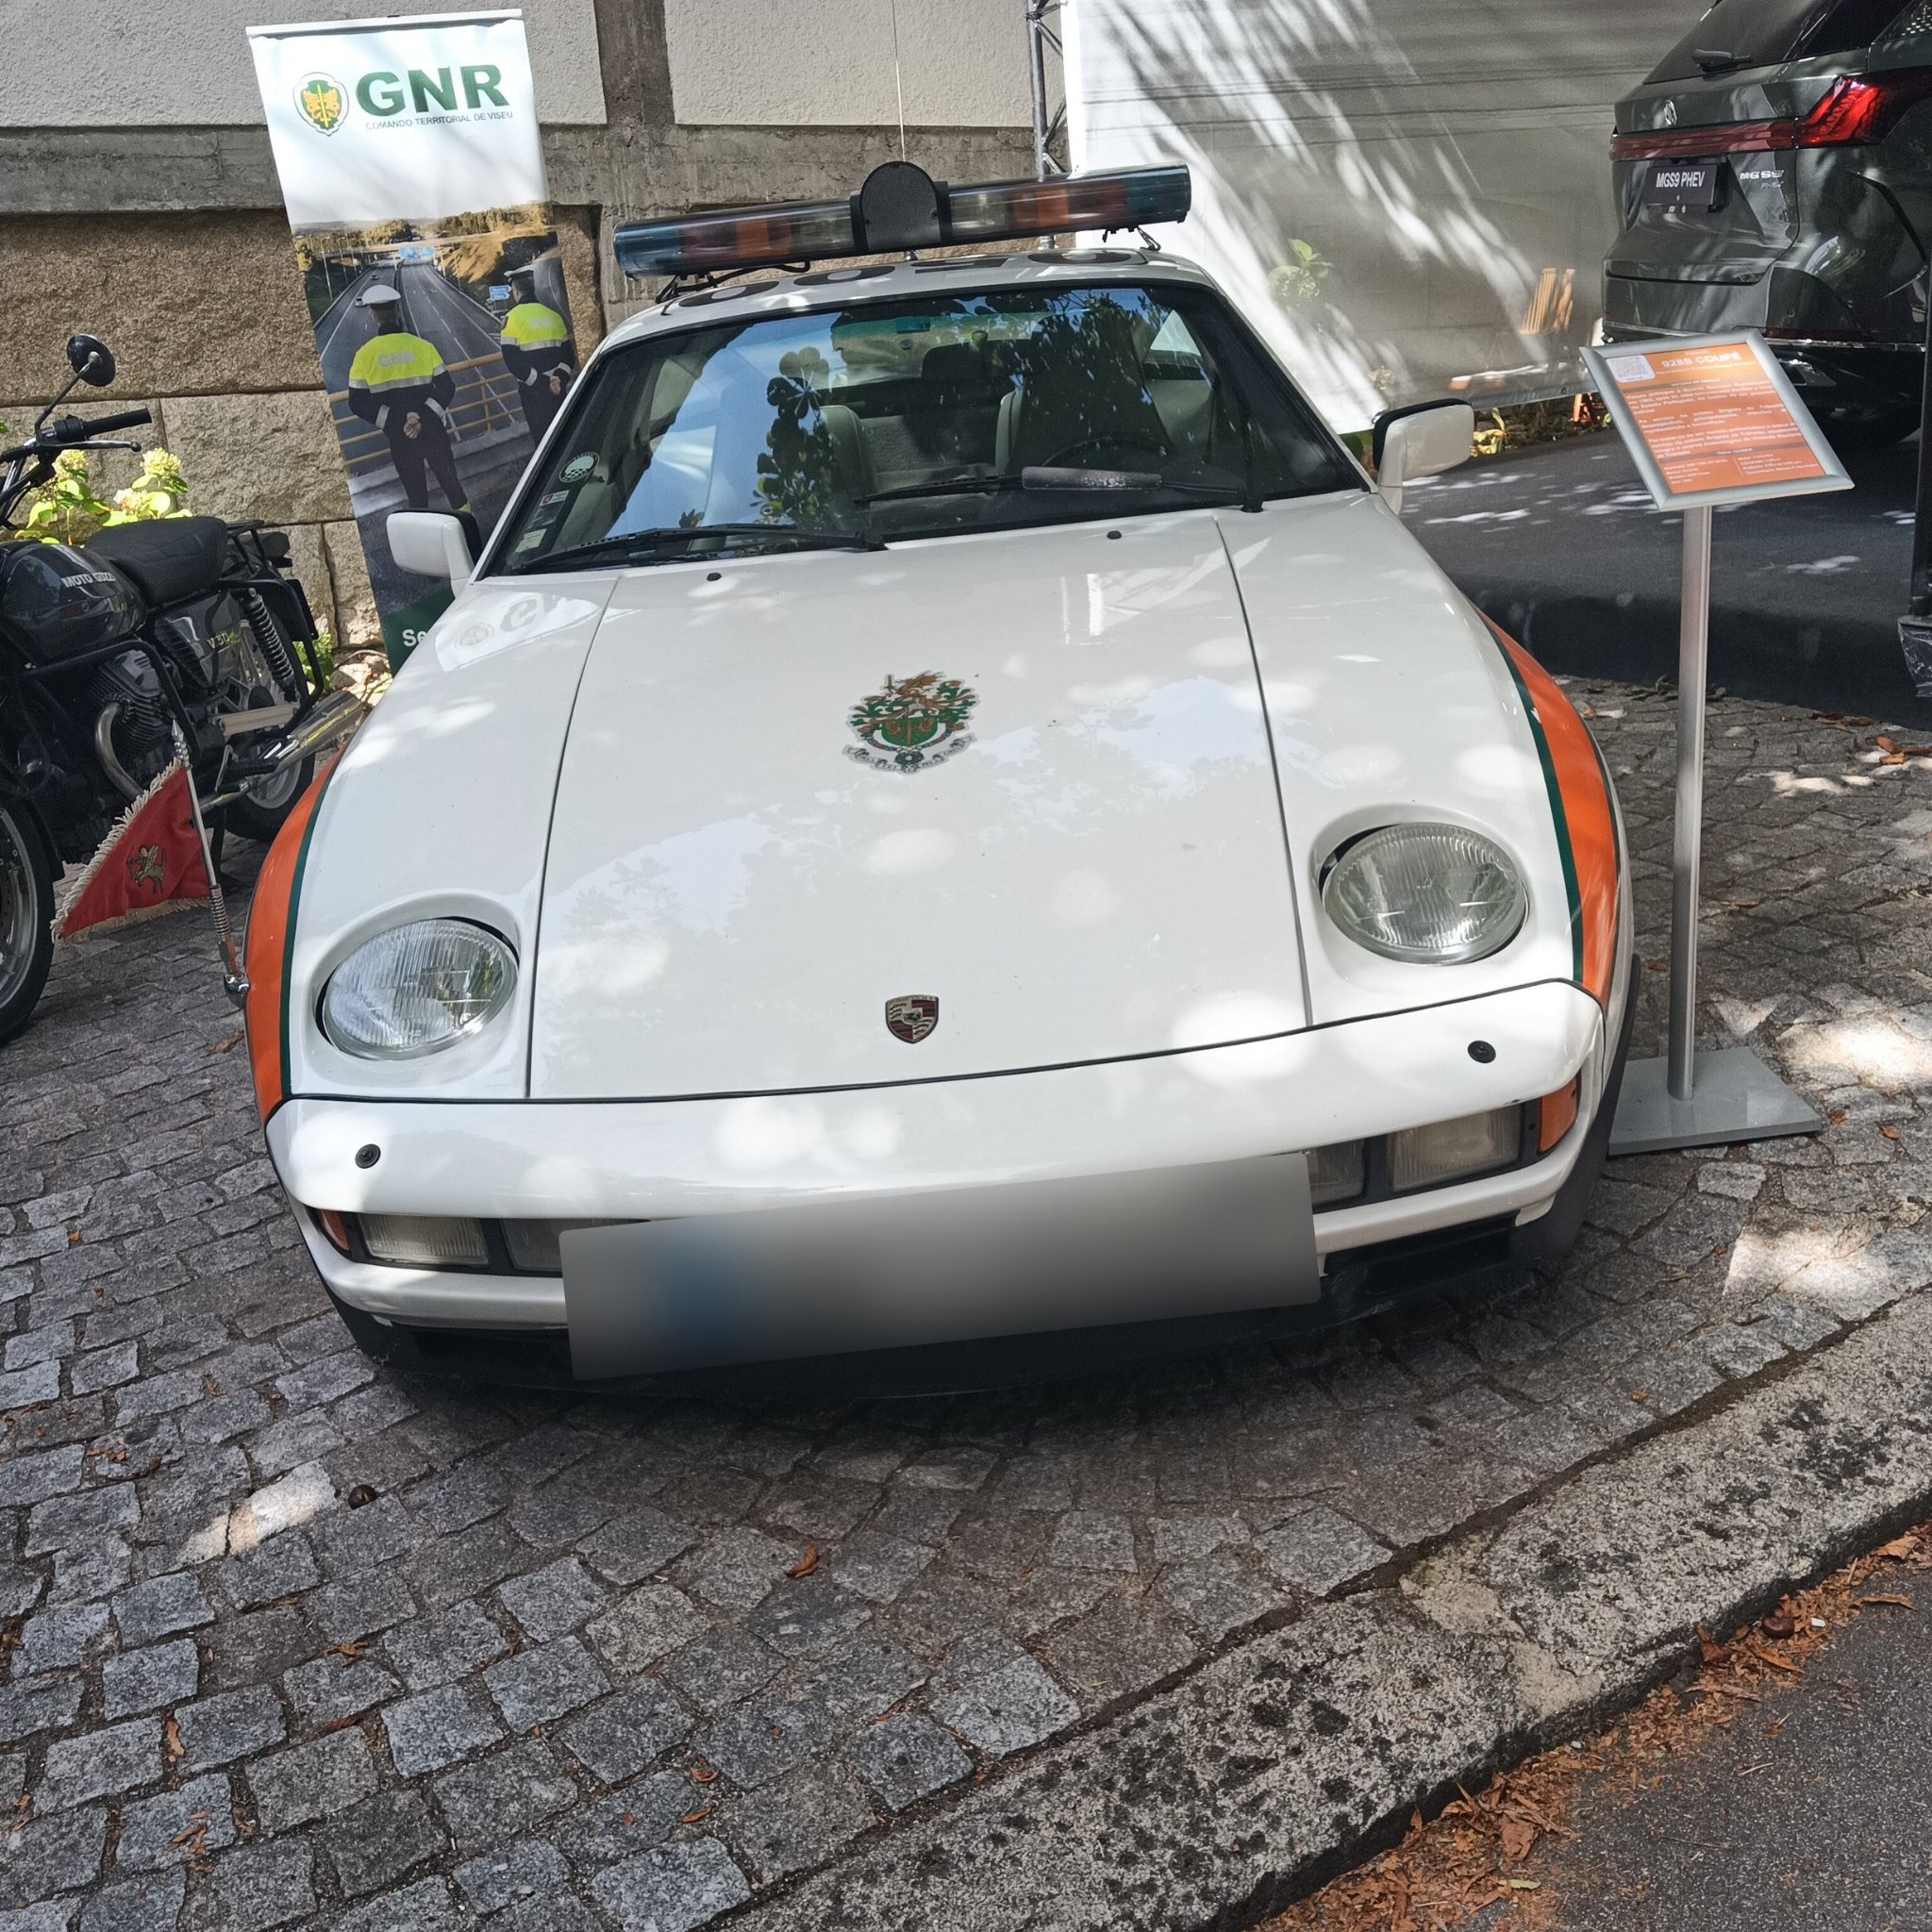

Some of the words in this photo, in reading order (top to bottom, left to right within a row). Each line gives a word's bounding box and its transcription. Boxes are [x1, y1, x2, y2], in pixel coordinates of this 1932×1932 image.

[356, 64, 509, 117] GNR
[366, 119, 413, 130] COMANDO
[415, 115, 472, 126] TERRITORIAL
[474, 113, 487, 122] DE
[487, 110, 513, 120] VISEU
[1656, 173, 1680, 188] MGS9
[1681, 171, 1706, 188] PHEV
[1740, 171, 1783, 180] MGS9
[1661, 358, 1692, 368] 928S
[60, 574, 93, 588] MOTO
